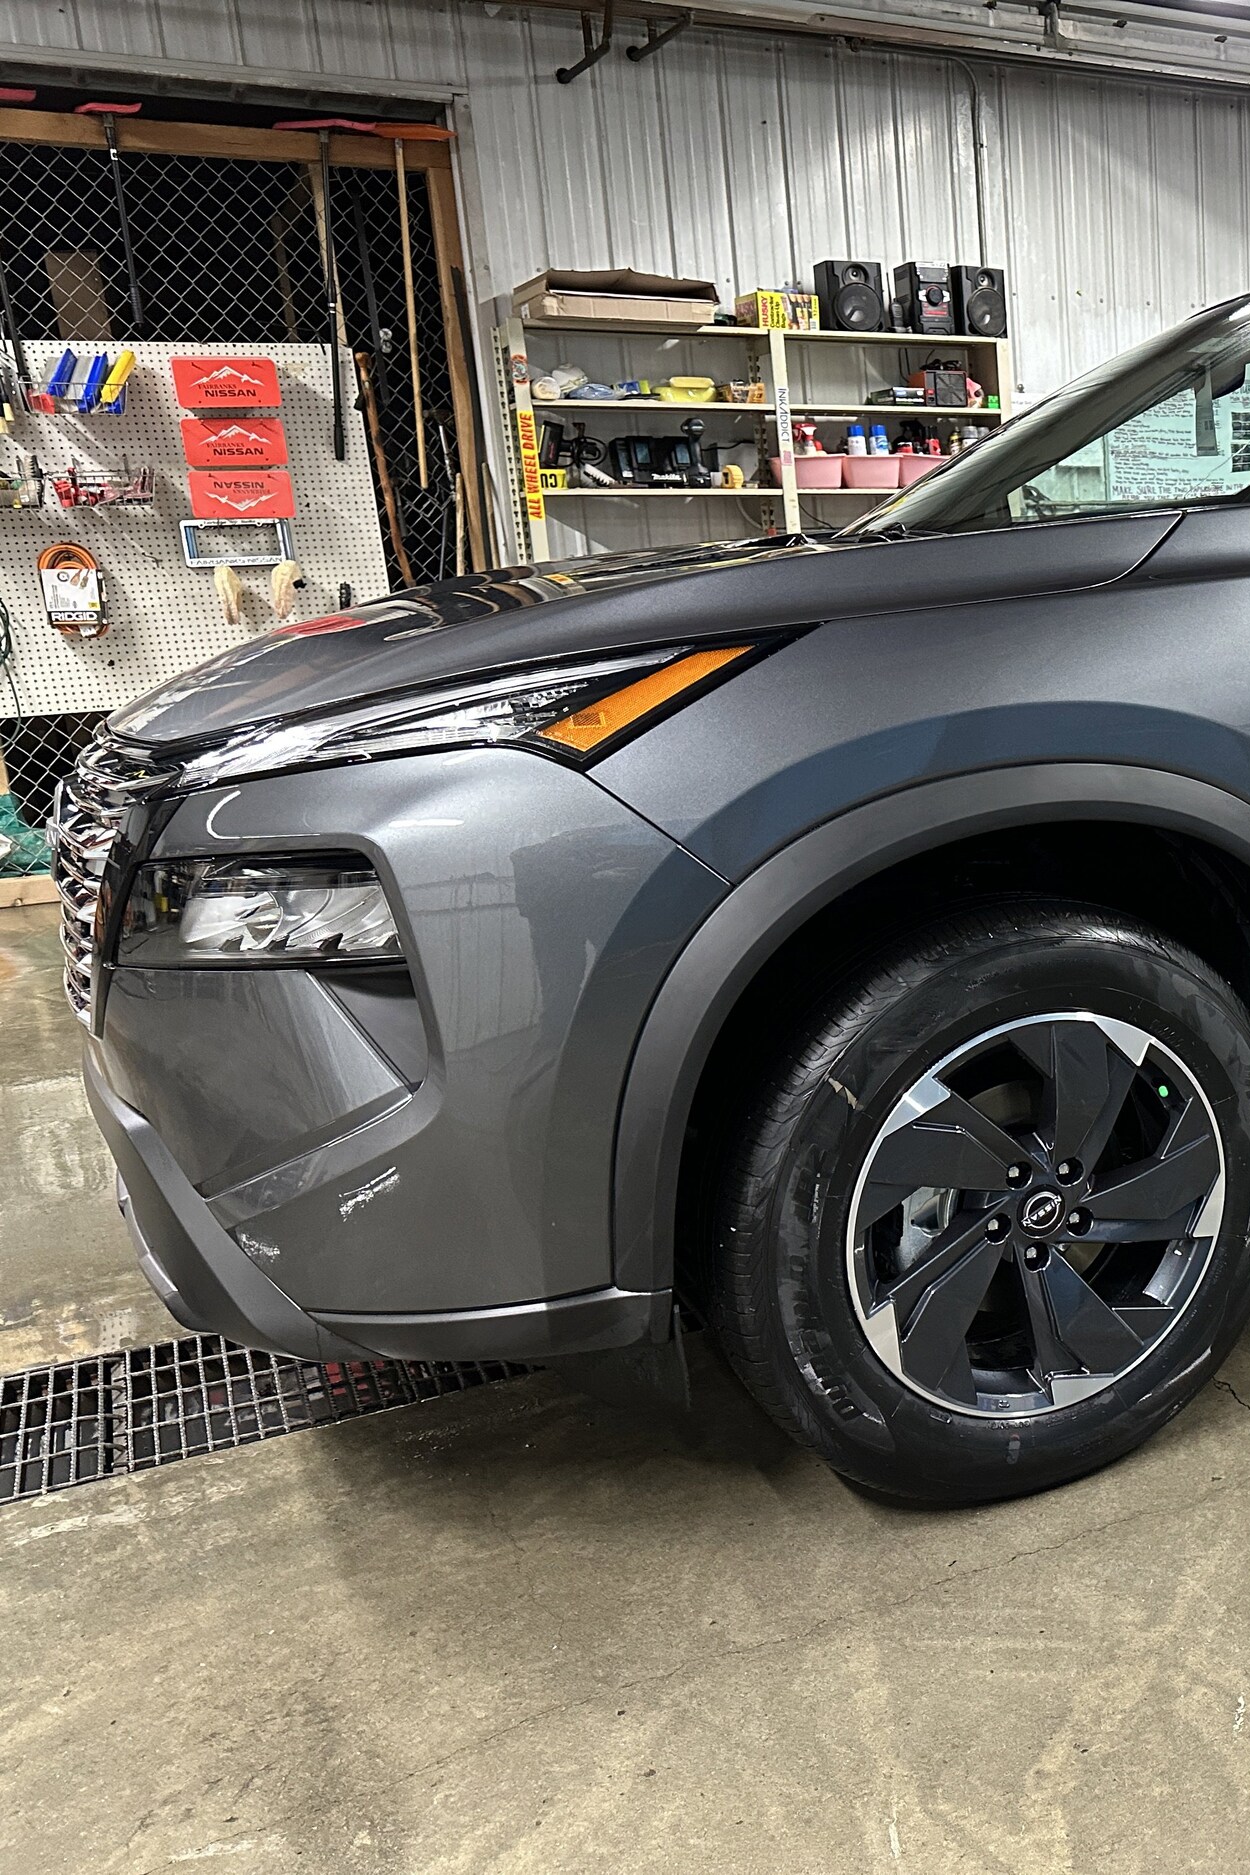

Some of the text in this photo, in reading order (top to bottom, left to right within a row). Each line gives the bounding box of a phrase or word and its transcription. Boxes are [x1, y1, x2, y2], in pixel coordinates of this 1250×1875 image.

[761, 295, 769, 327] HUSKY
[204, 389, 257, 398] NISSAN
[213, 448, 265, 456] NISSAN
[519, 412, 543, 519] ALL WHEEL DRIVE
[213, 481, 265, 489] NISSAN
[1112, 485, 1133, 496] MAKE
[50, 611, 98, 621] RIDGID
[1021, 1195, 1062, 1227] NISSAN
